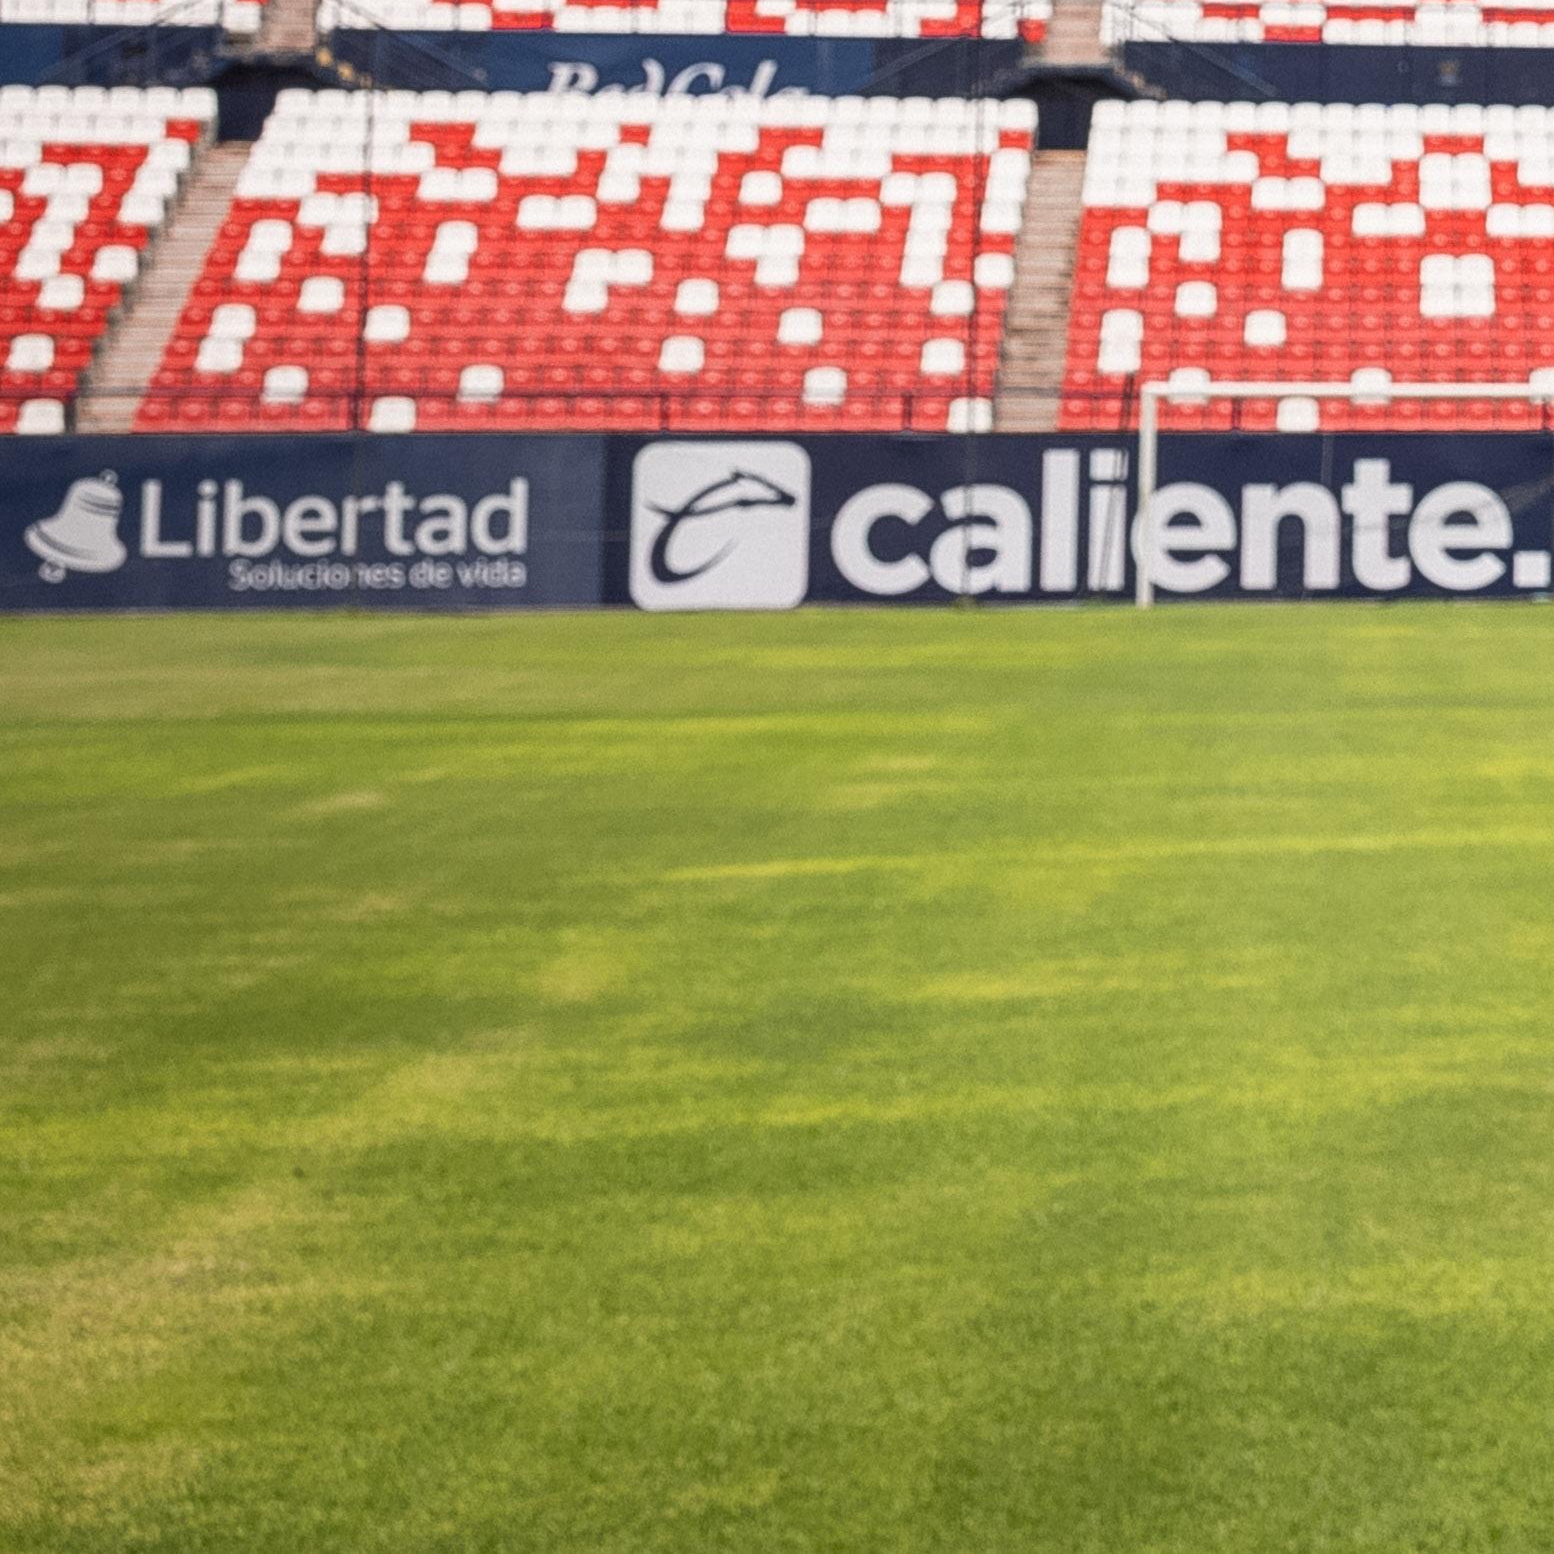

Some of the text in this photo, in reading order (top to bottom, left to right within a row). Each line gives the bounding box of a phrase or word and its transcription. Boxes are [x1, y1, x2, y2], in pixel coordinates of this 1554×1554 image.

[140, 476, 530, 558] Libertad
[228, 555, 529, 592] Soluciones de vida
